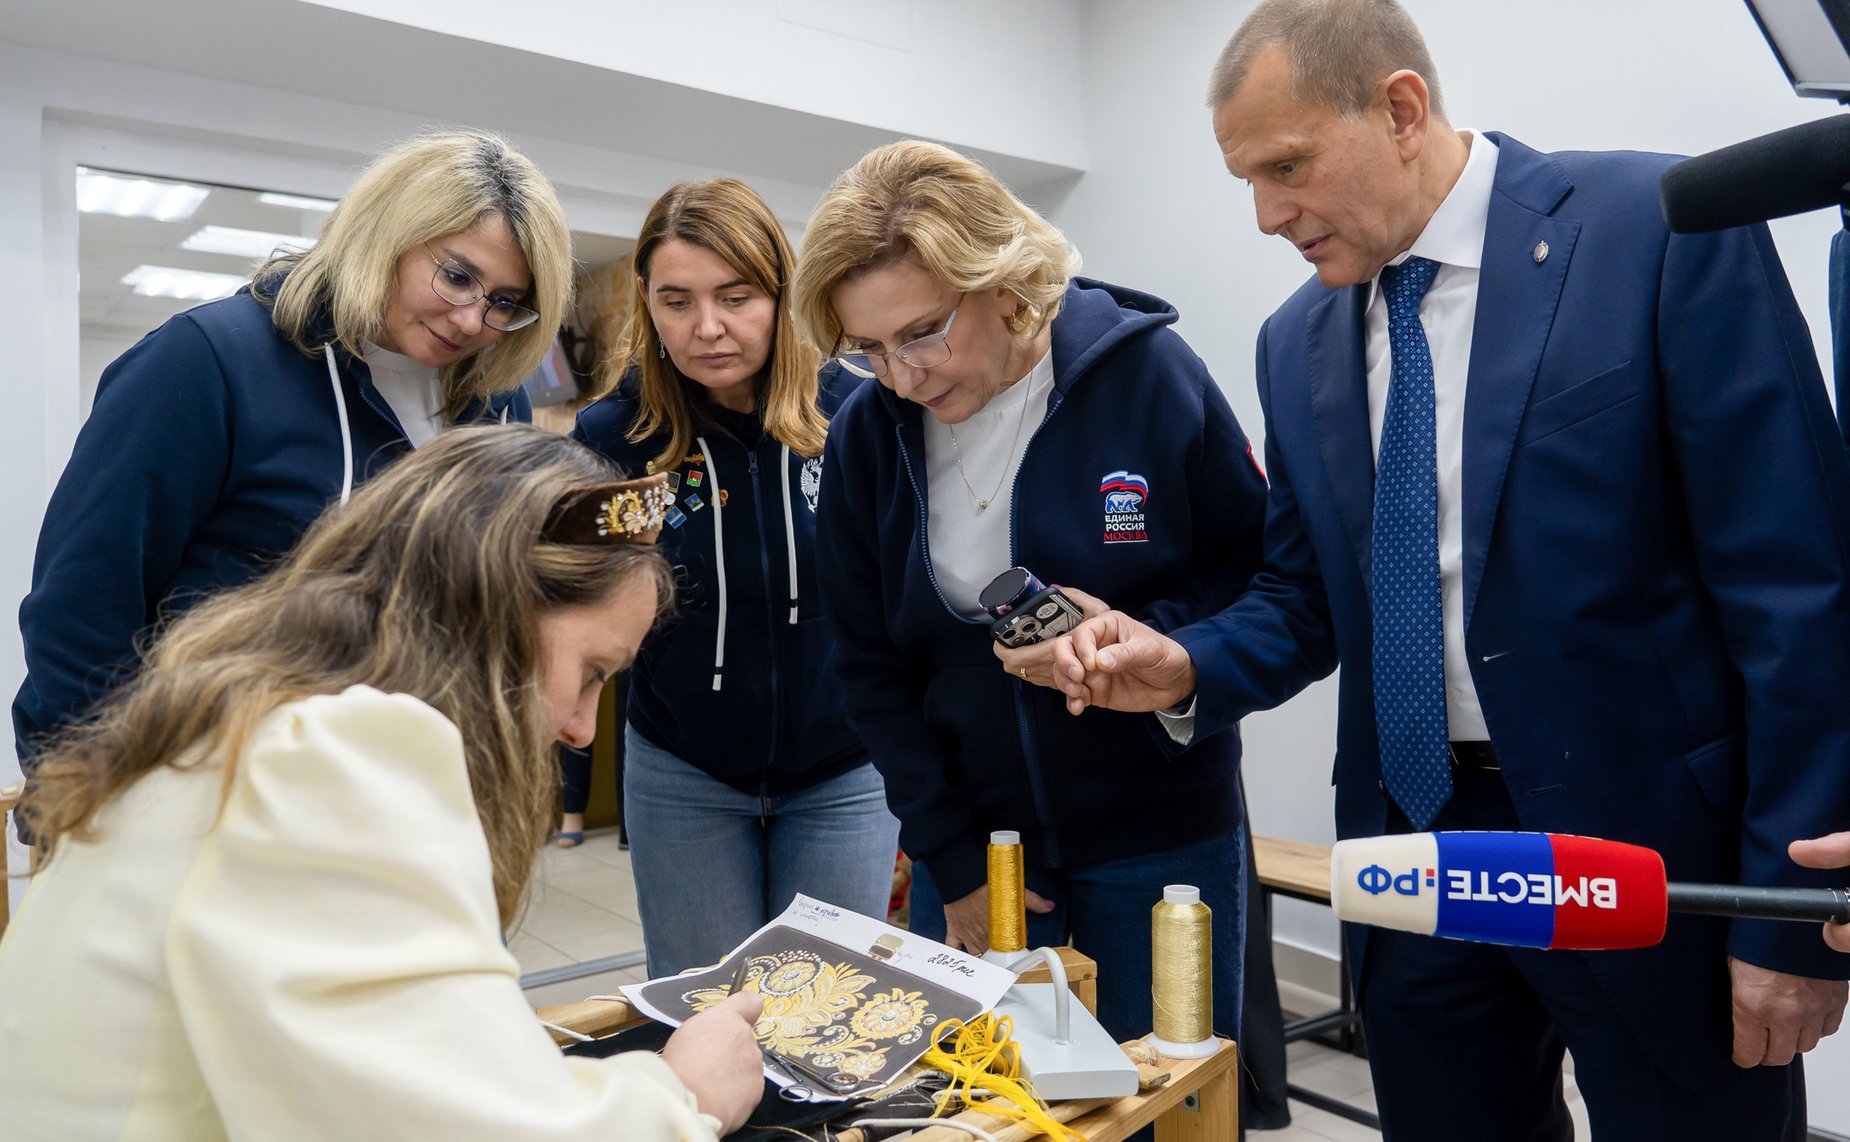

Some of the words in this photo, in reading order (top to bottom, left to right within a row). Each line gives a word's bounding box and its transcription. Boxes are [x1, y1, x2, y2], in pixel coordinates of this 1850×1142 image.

[1104, 513, 1145, 523] ЕДИНАЯ
[1105, 522, 1145, 532] РОССИЯ
[1103, 531, 1148, 540] МОСКВА
[1446, 869, 1617, 909] ВМЕСТЕ
